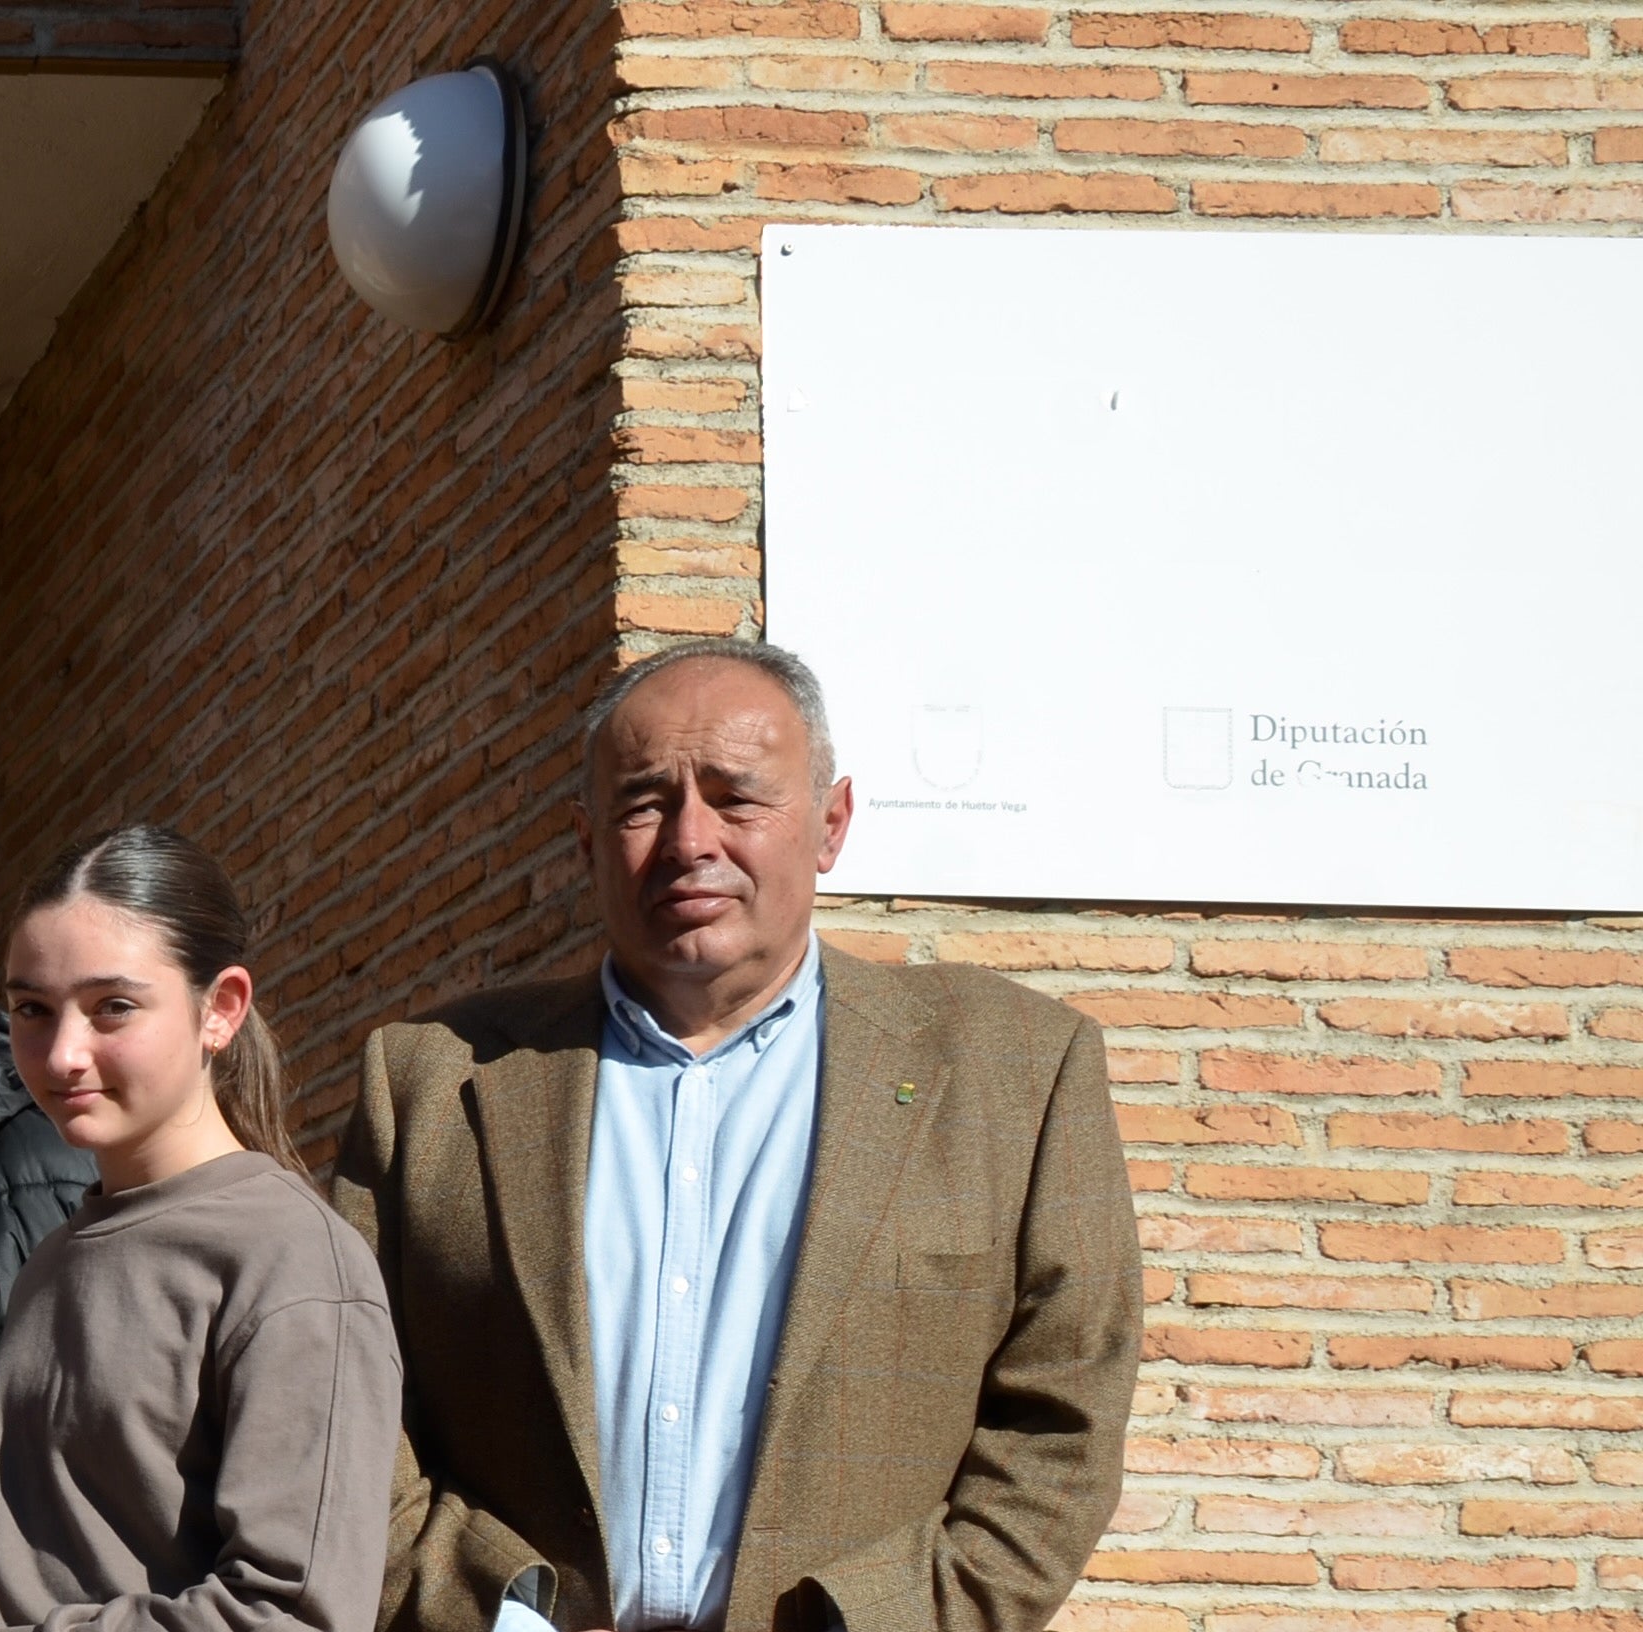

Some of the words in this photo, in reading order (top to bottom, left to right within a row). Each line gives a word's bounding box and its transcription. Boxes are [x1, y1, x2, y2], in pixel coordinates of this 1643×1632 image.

[1249, 714, 1428, 749] Diputación
[1251, 759, 1285, 787] de
[868, 798, 941, 810] Ayuntamiento
[945, 800, 958, 810] de
[1001, 800, 1028, 813] Vega
